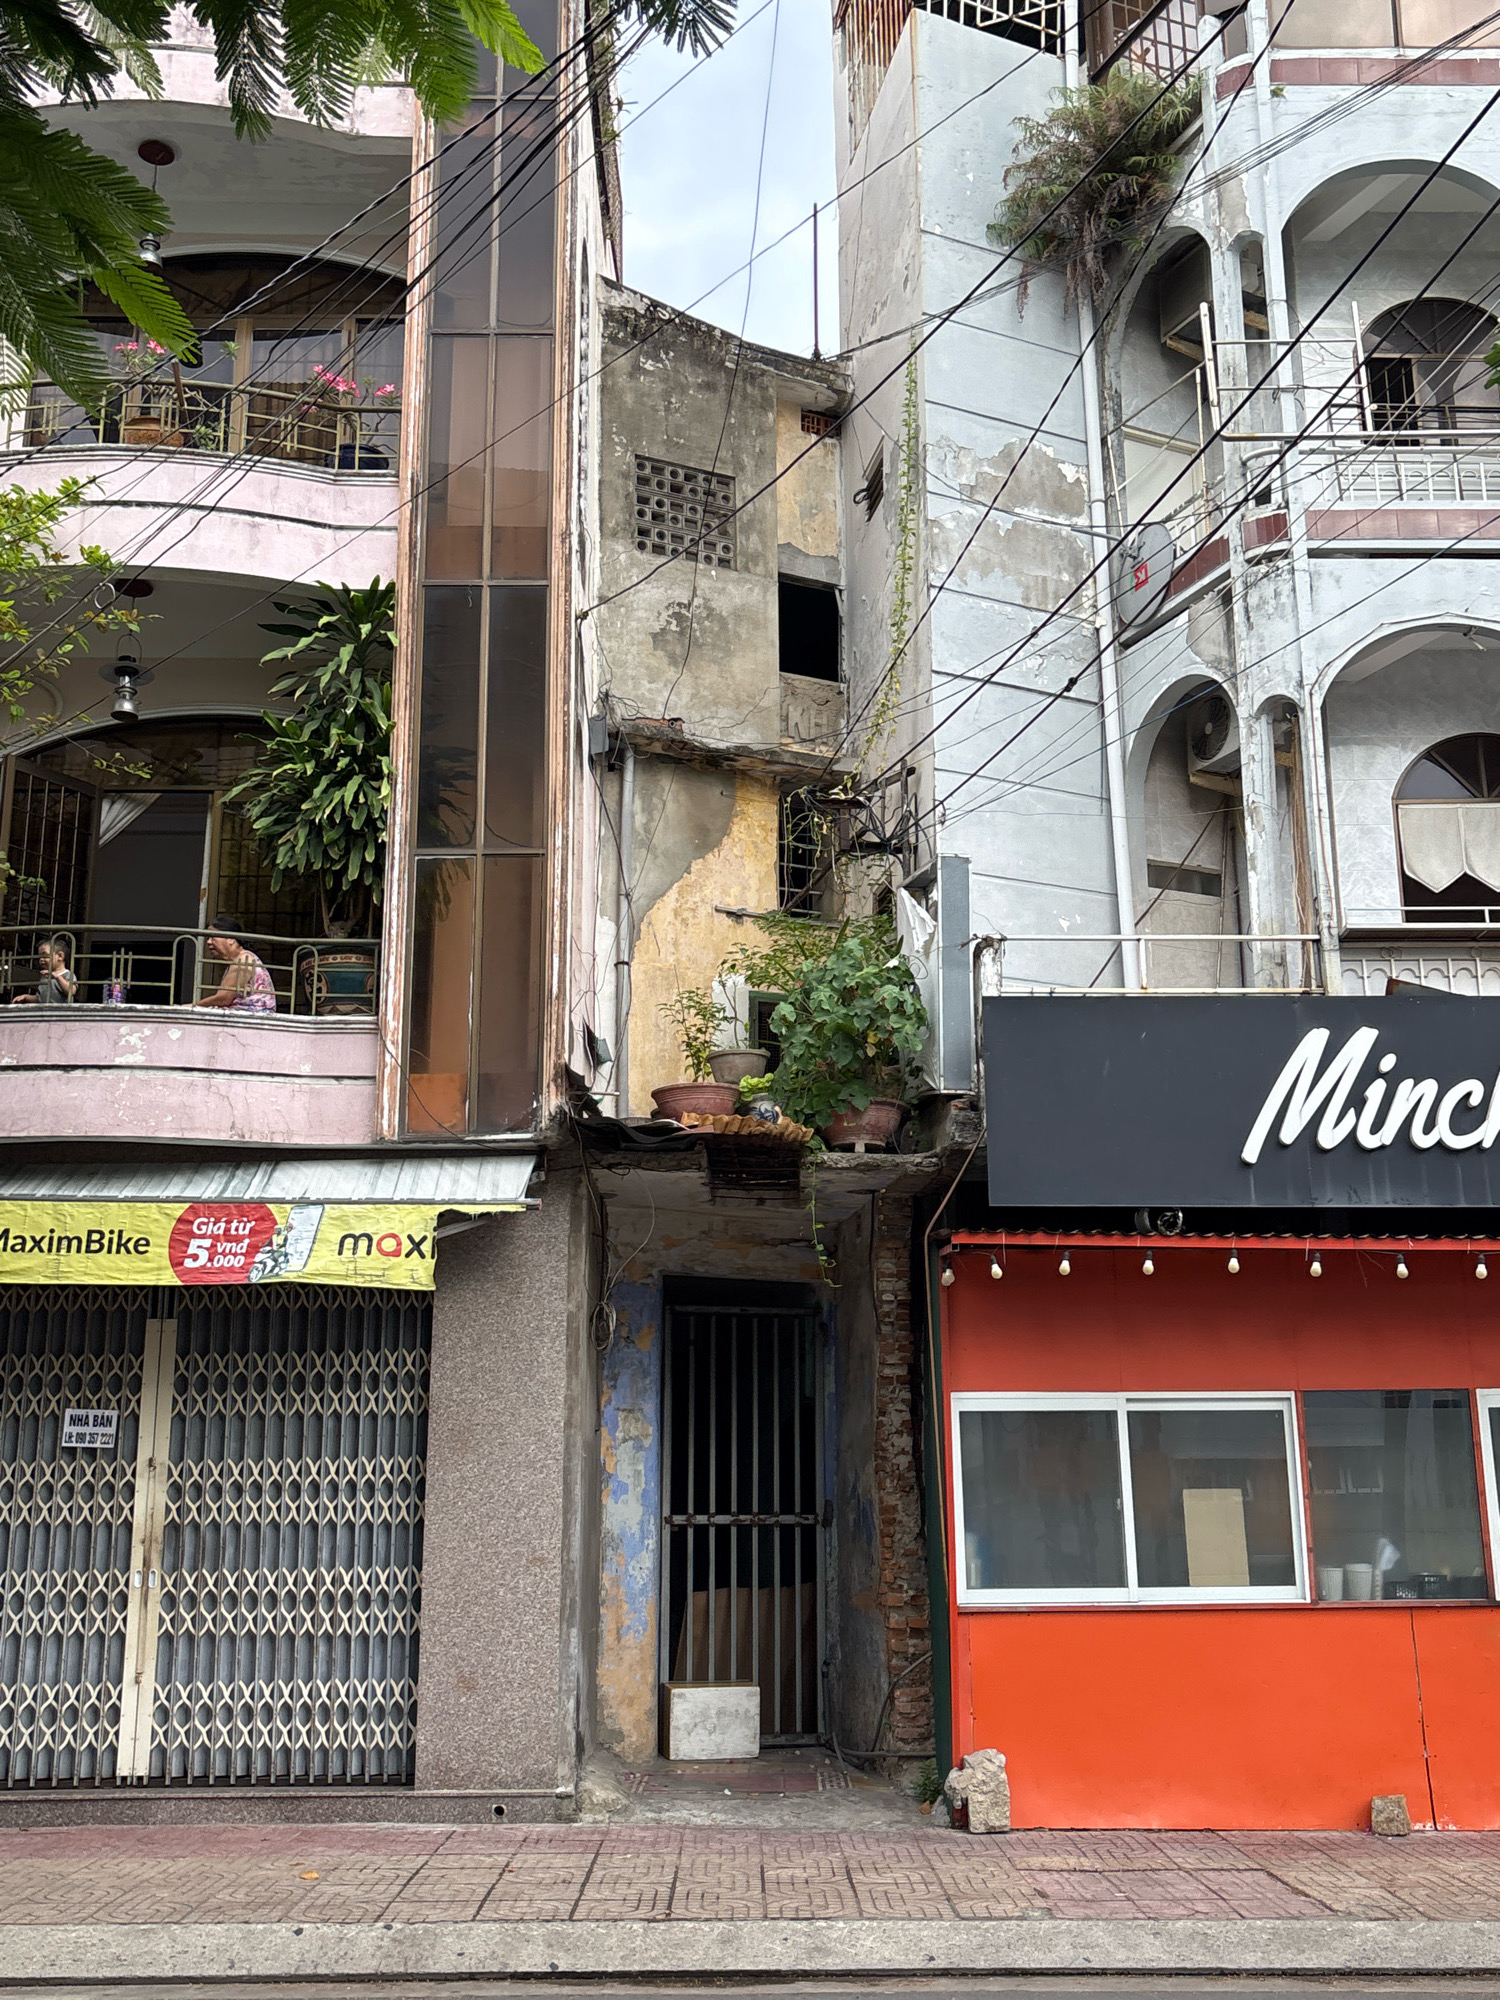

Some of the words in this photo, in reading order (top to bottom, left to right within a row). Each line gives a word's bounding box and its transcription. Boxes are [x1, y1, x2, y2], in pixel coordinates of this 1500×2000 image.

[1241, 1026, 1500, 1165] Minc
[192, 1217, 226, 1236] Giá
[230, 1217, 256, 1235] từ
[216, 1238, 250, 1254] vnđ
[69, 1412, 89, 1427] NHÀ
[93, 1412, 113, 1427] BÁN
